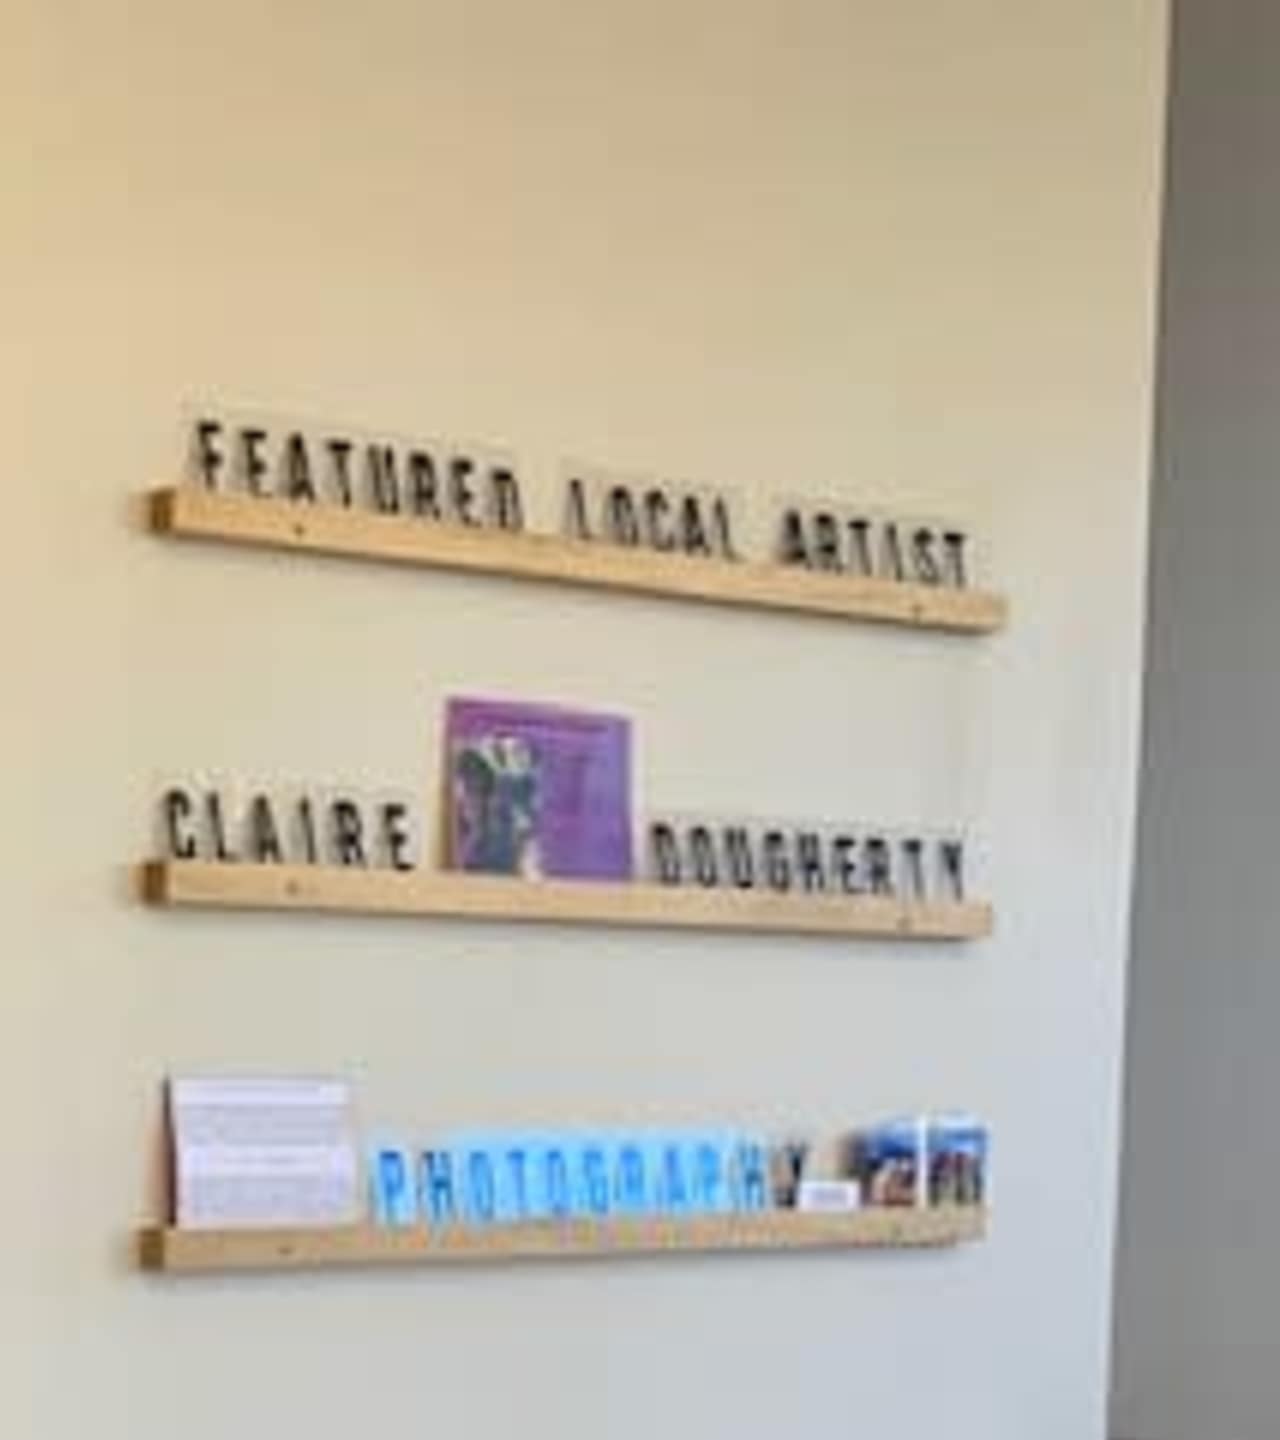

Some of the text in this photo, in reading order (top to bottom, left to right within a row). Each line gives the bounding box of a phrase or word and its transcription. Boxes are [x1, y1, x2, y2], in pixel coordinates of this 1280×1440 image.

[194, 420, 970, 588] FEATURED LOCAL ARTIST
[165, 789, 967, 899] CLAIRE DOUGHERTY
[376, 1142, 808, 1224] PHOTOGRAPHY
